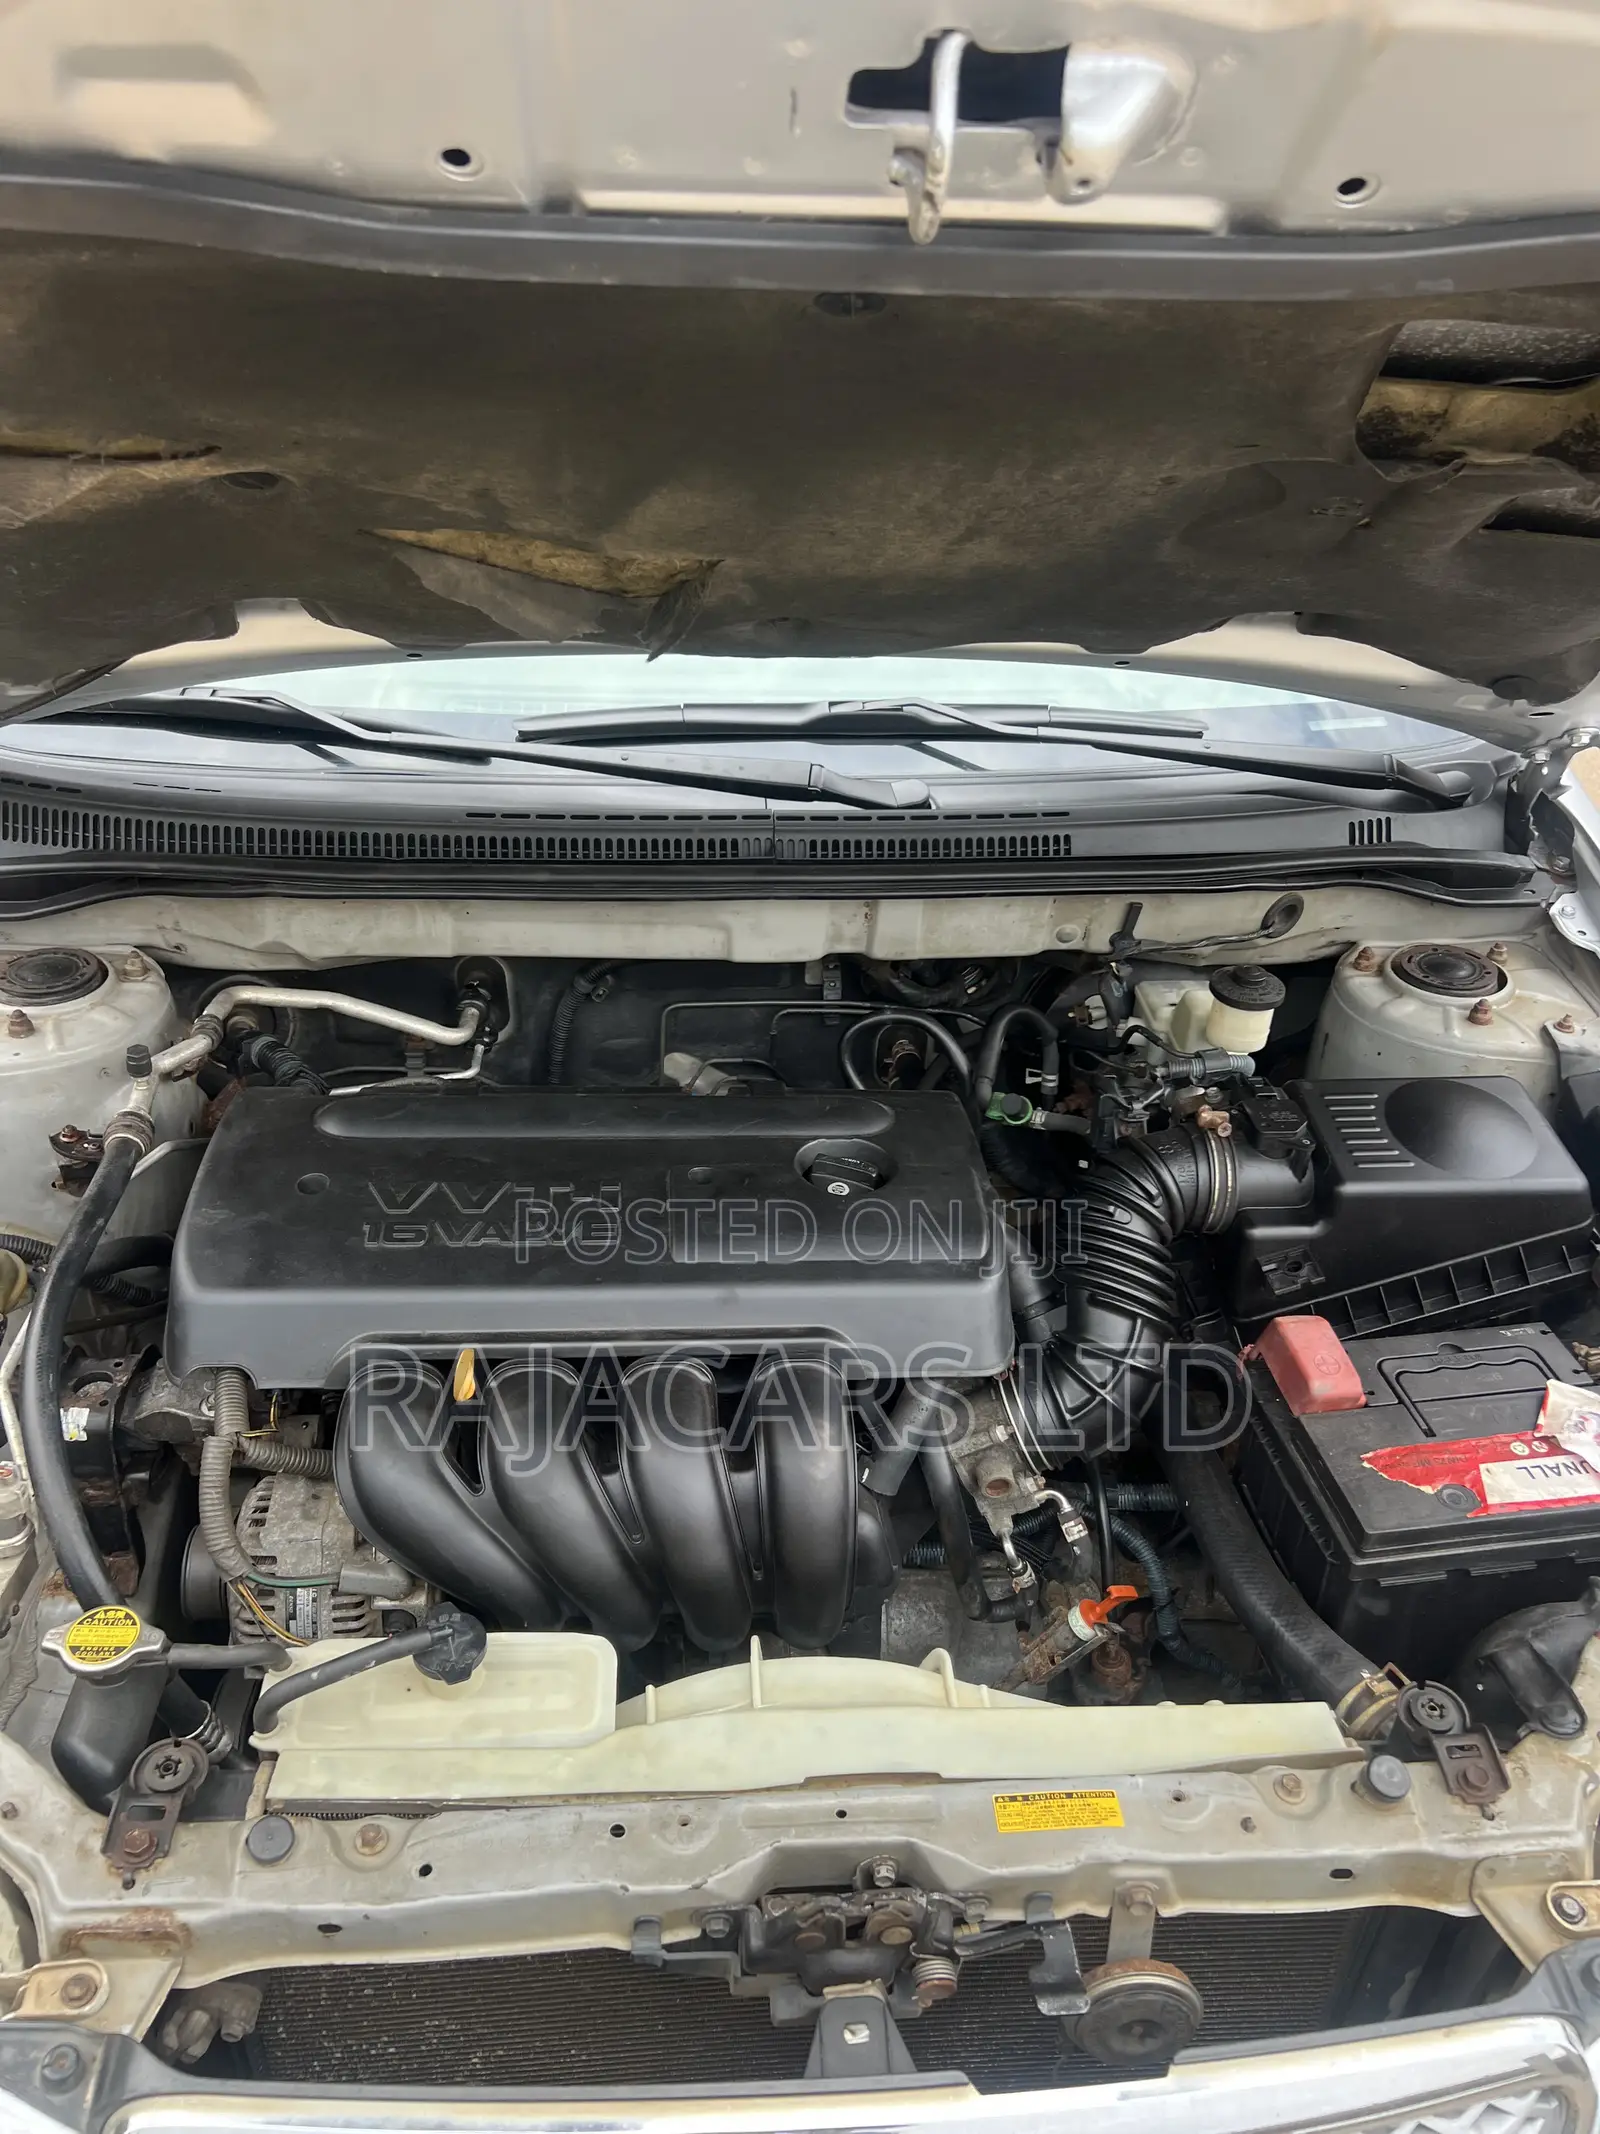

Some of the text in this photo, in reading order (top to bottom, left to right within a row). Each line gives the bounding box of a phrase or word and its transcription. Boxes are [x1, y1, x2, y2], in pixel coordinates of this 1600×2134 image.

[83, 1618, 134, 1626] CAUTION
[1028, 1793, 1067, 1801] CAUTION
[1072, 1791, 1113, 1799] ATTENTION
